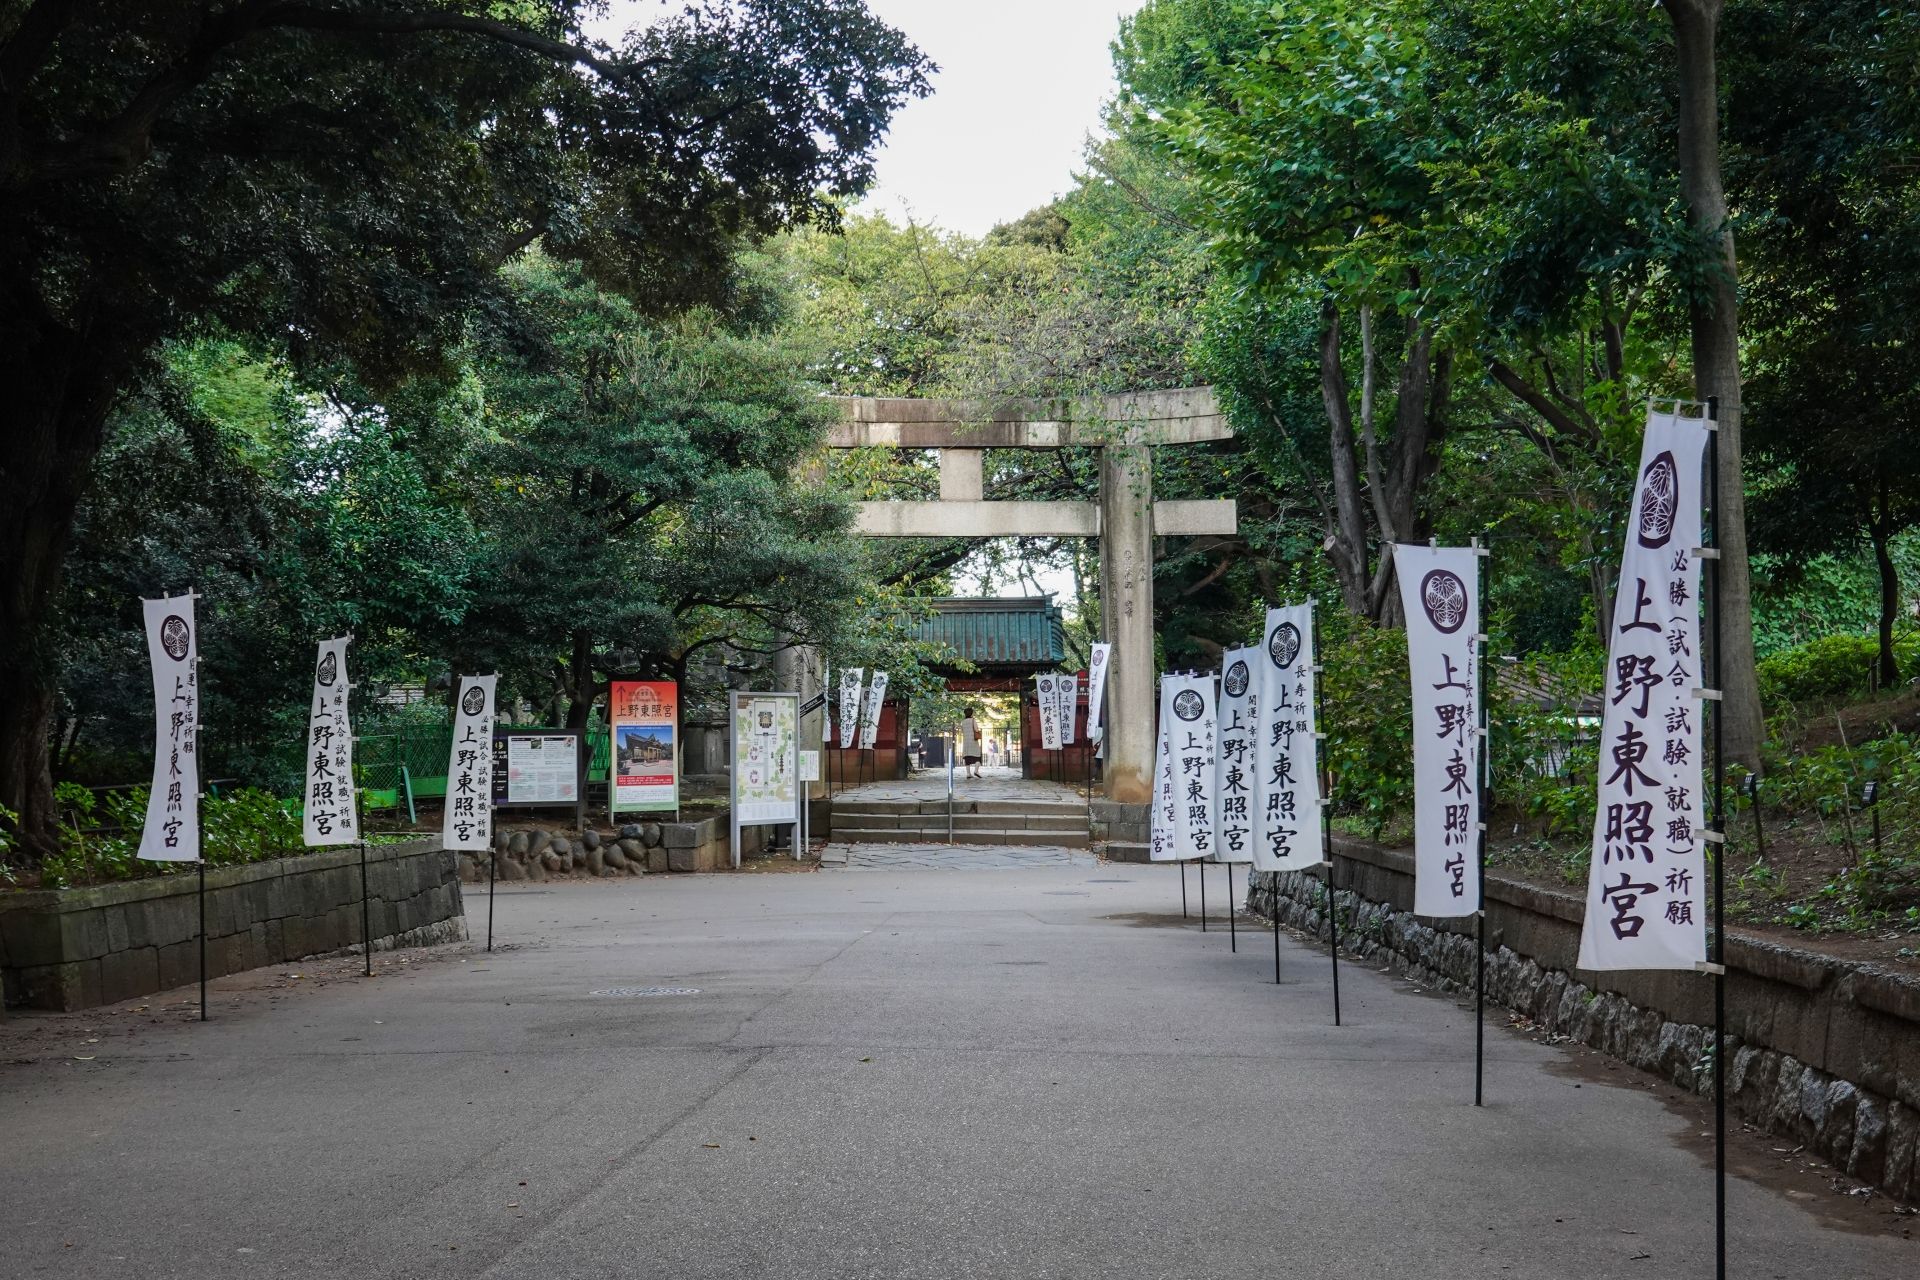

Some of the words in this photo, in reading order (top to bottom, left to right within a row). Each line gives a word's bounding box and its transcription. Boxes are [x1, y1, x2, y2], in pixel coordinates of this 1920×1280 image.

[162, 675, 186, 848] 上野東照宮
[311, 697, 336, 836] 上野東照宮
[334, 684, 352, 829] 必勝（試合・試験・就職）祈願
[616, 704, 673, 718] 上野東照宮
[1042, 695, 1055, 745] 上野東照宮
[1203, 718, 1215, 767] 長寿祈願
[1294, 664, 1308, 733] 長寿祈願
[1601, 578, 1663, 941] 上野東照宮
[1663, 549, 1695, 926] 必勝（試合・試験・就職）祈願
[453, 725, 477, 842] 上野東照宮
[1181, 731, 1212, 852] 上野東照宮
[1222, 709, 1250, 851] 上野東照宮
[1266, 683, 1298, 859] 上野東照宮
[1431, 653, 1471, 898] 上野東照宮
